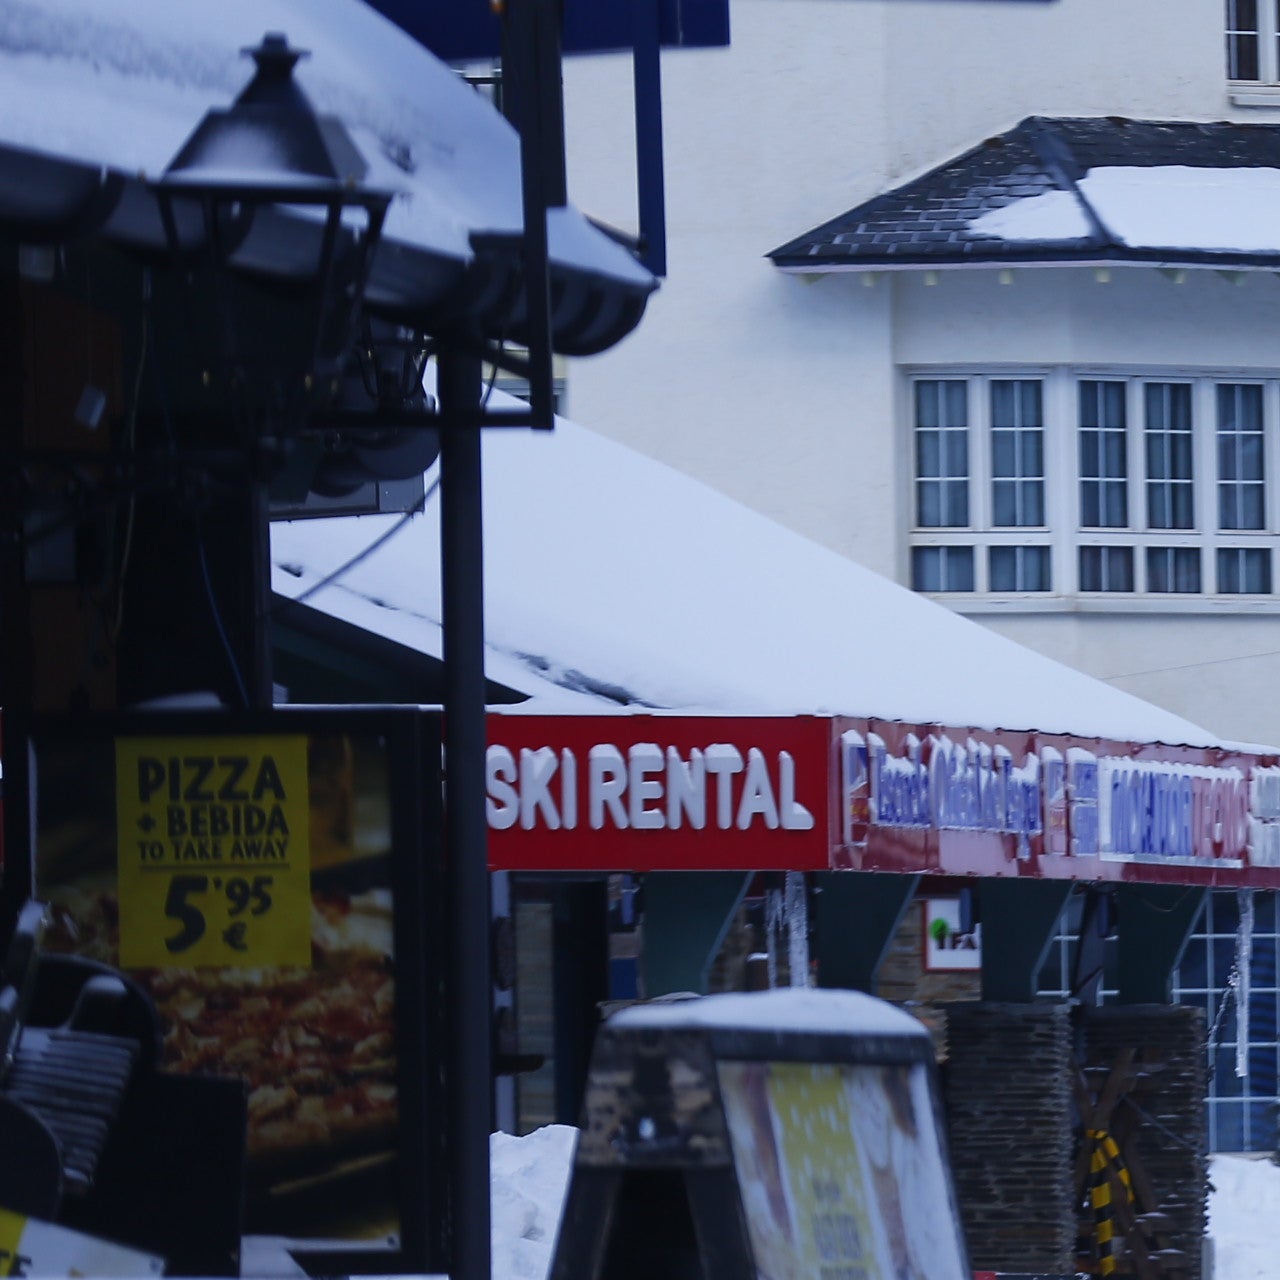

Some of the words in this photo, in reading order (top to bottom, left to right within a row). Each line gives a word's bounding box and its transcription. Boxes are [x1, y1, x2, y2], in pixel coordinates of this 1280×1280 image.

[137, 755, 287, 802] PIZZA
[486, 744, 577, 830] SKI
[588, 742, 815, 830] RENTAL
[166, 803, 290, 838] BEBIDA
[138, 839, 165, 861] TO
[174, 839, 222, 861] TAKE
[231, 838, 288, 861] AWAY
[222, 921, 248, 951] €
